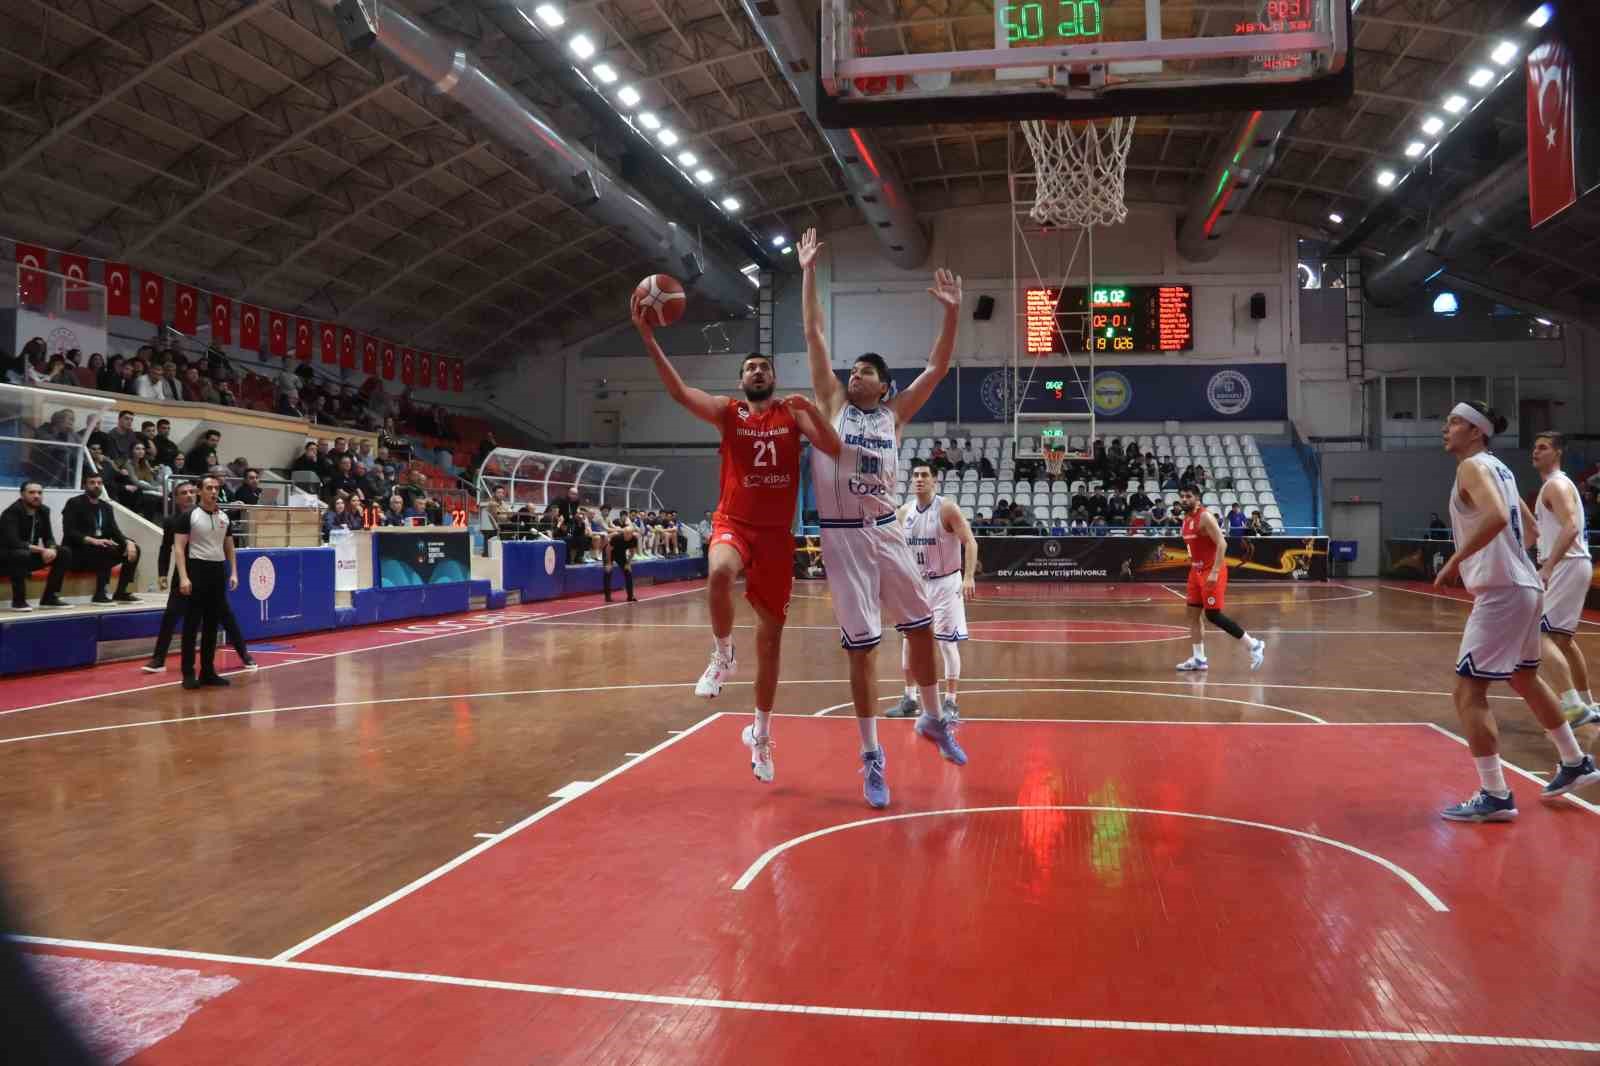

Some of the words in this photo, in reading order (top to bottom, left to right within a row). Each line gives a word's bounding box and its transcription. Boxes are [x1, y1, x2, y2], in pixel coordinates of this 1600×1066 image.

[752, 440, 777, 467] 21
[998, 569, 1012, 577] DEV
[1014, 569, 1048, 577] ADAMLAR
